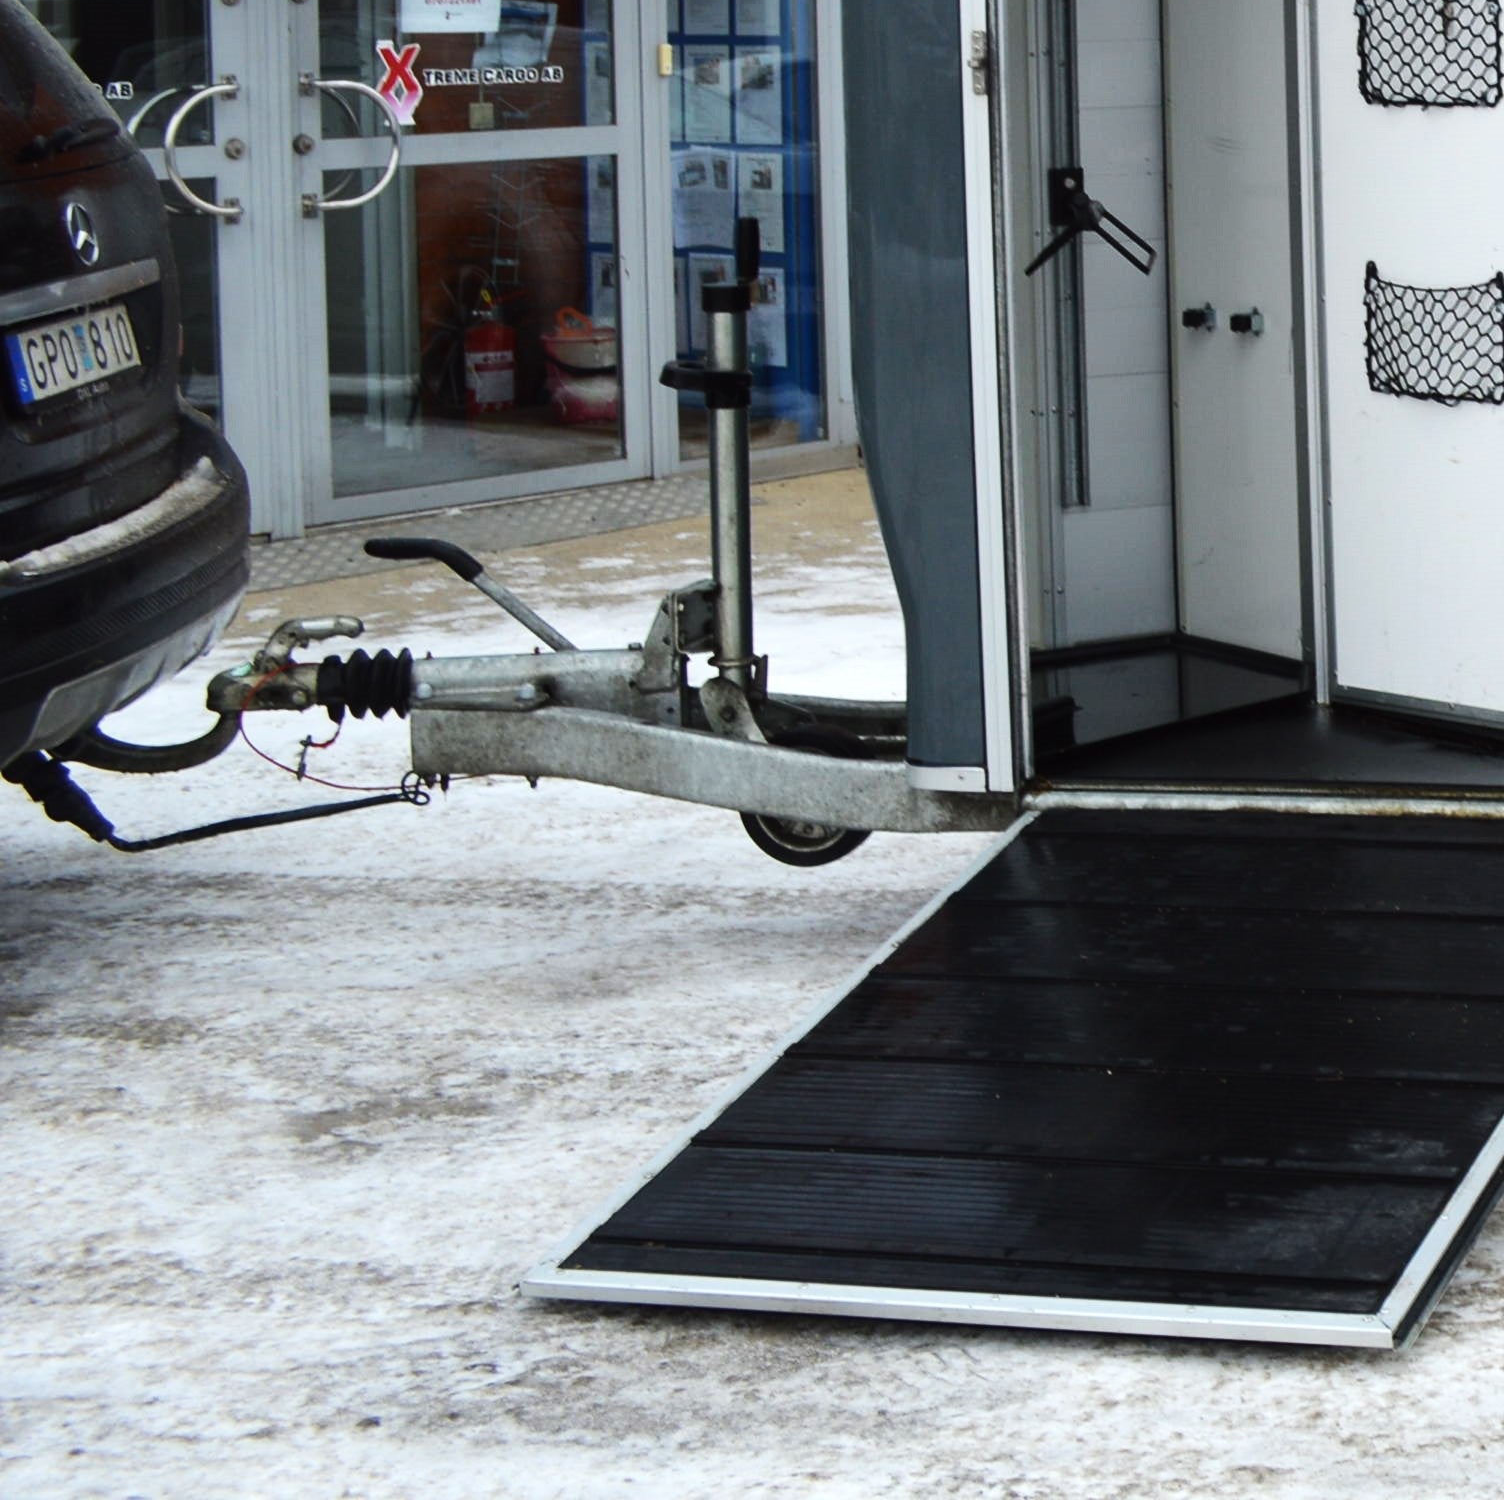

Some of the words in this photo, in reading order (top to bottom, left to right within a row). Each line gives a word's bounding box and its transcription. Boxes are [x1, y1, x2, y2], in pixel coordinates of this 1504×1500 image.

[481, 67, 539, 85] CARGO
[541, 65, 564, 83] AB
[105, 81, 134, 100] AB
